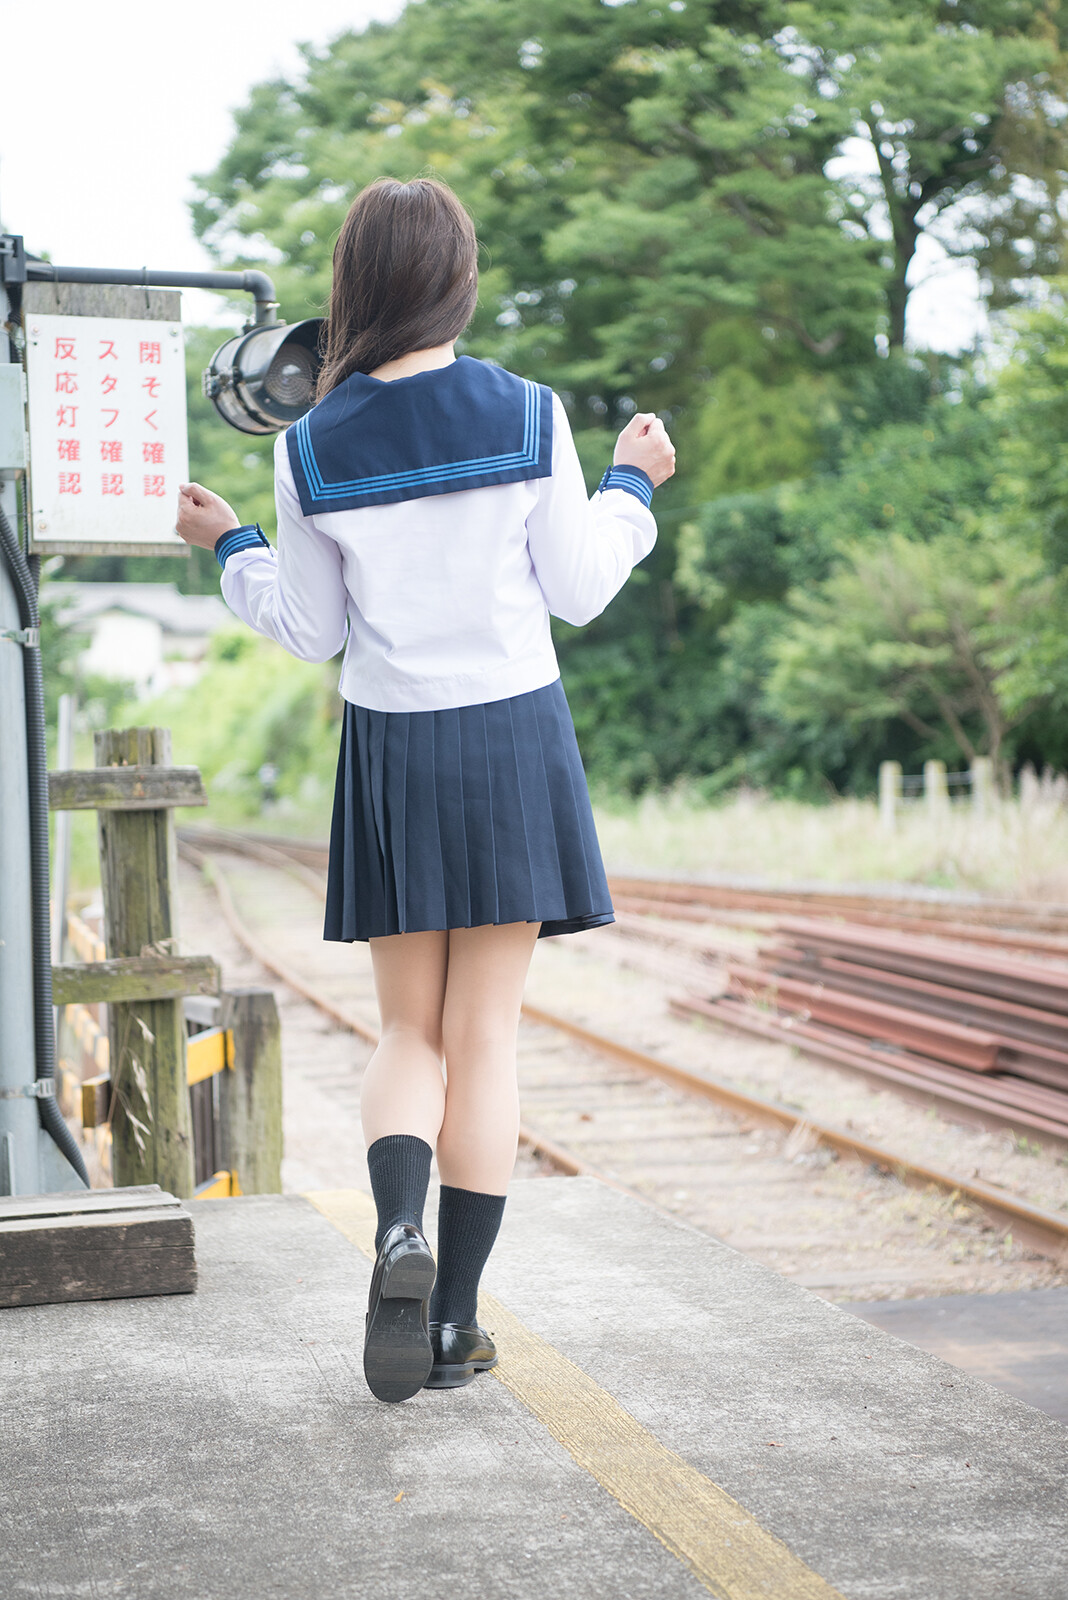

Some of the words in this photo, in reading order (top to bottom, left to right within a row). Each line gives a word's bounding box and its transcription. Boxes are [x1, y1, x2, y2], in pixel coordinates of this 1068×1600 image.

[54, 337, 82, 496] 反応灯確認
[98, 340, 125, 496] スタフ確認
[139, 341, 166, 497] 閉そく確認
